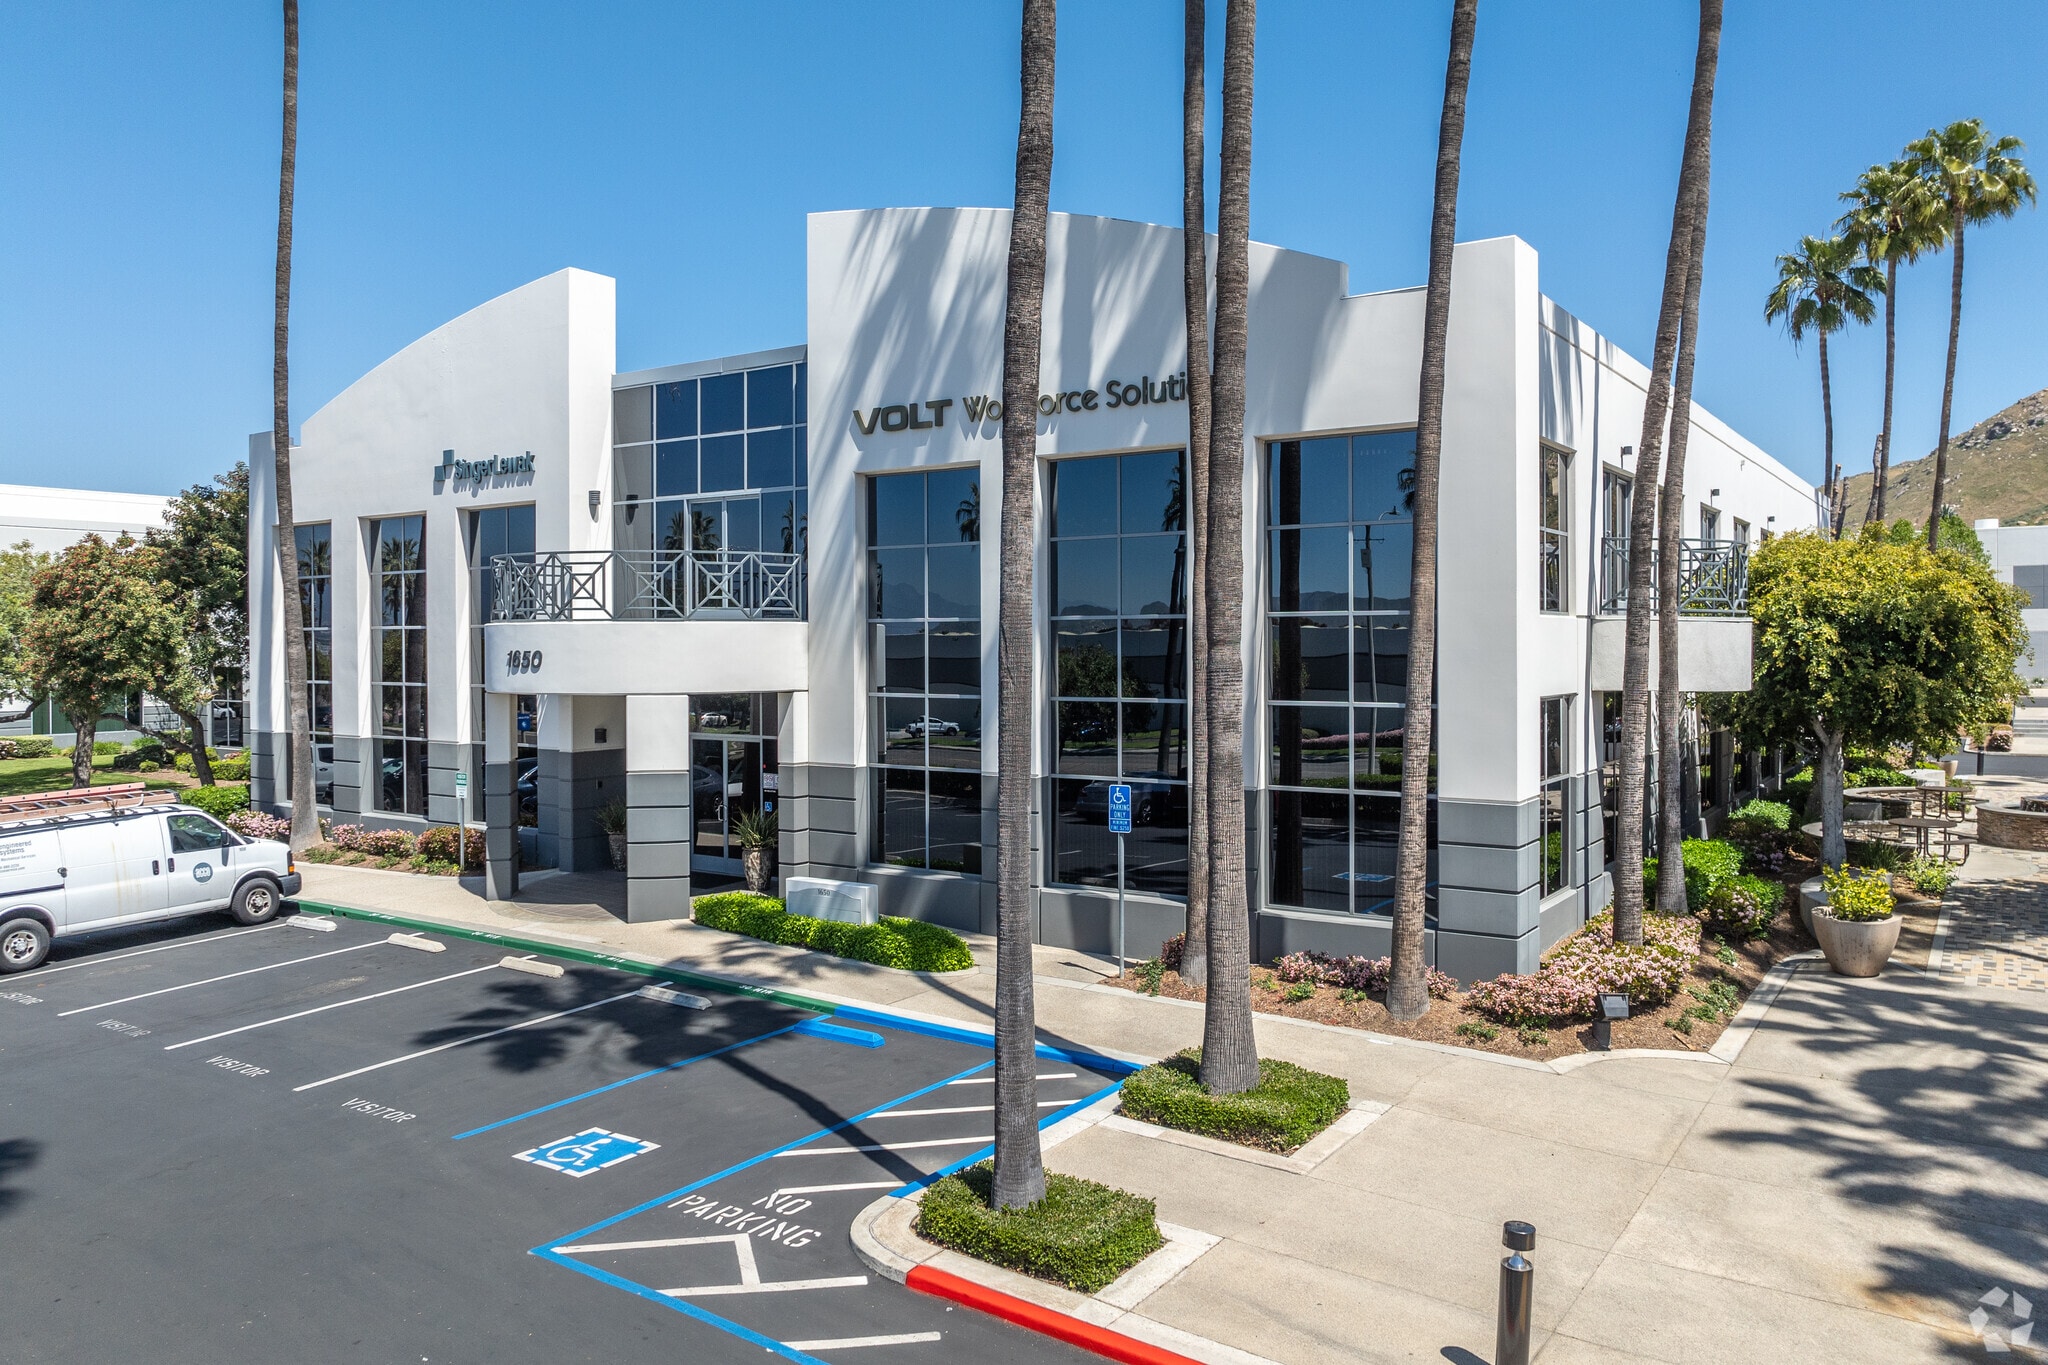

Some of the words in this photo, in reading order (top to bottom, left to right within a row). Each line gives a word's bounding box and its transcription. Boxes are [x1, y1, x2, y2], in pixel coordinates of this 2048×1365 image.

[853, 399, 953, 434] VOLT
[963, 389, 1099, 422] Woorce
[454, 451, 535, 484] SingerLewak
[506, 650, 543, 669] 1650
[817, 888, 831, 896] 1650
[96, 1018, 152, 1037] VISITOR
[205, 1055, 270, 1077] VISITOR
[341, 1097, 417, 1122] VISITOR
[752, 1190, 813, 1216] NO
[667, 1194, 822, 1248] PARKING
